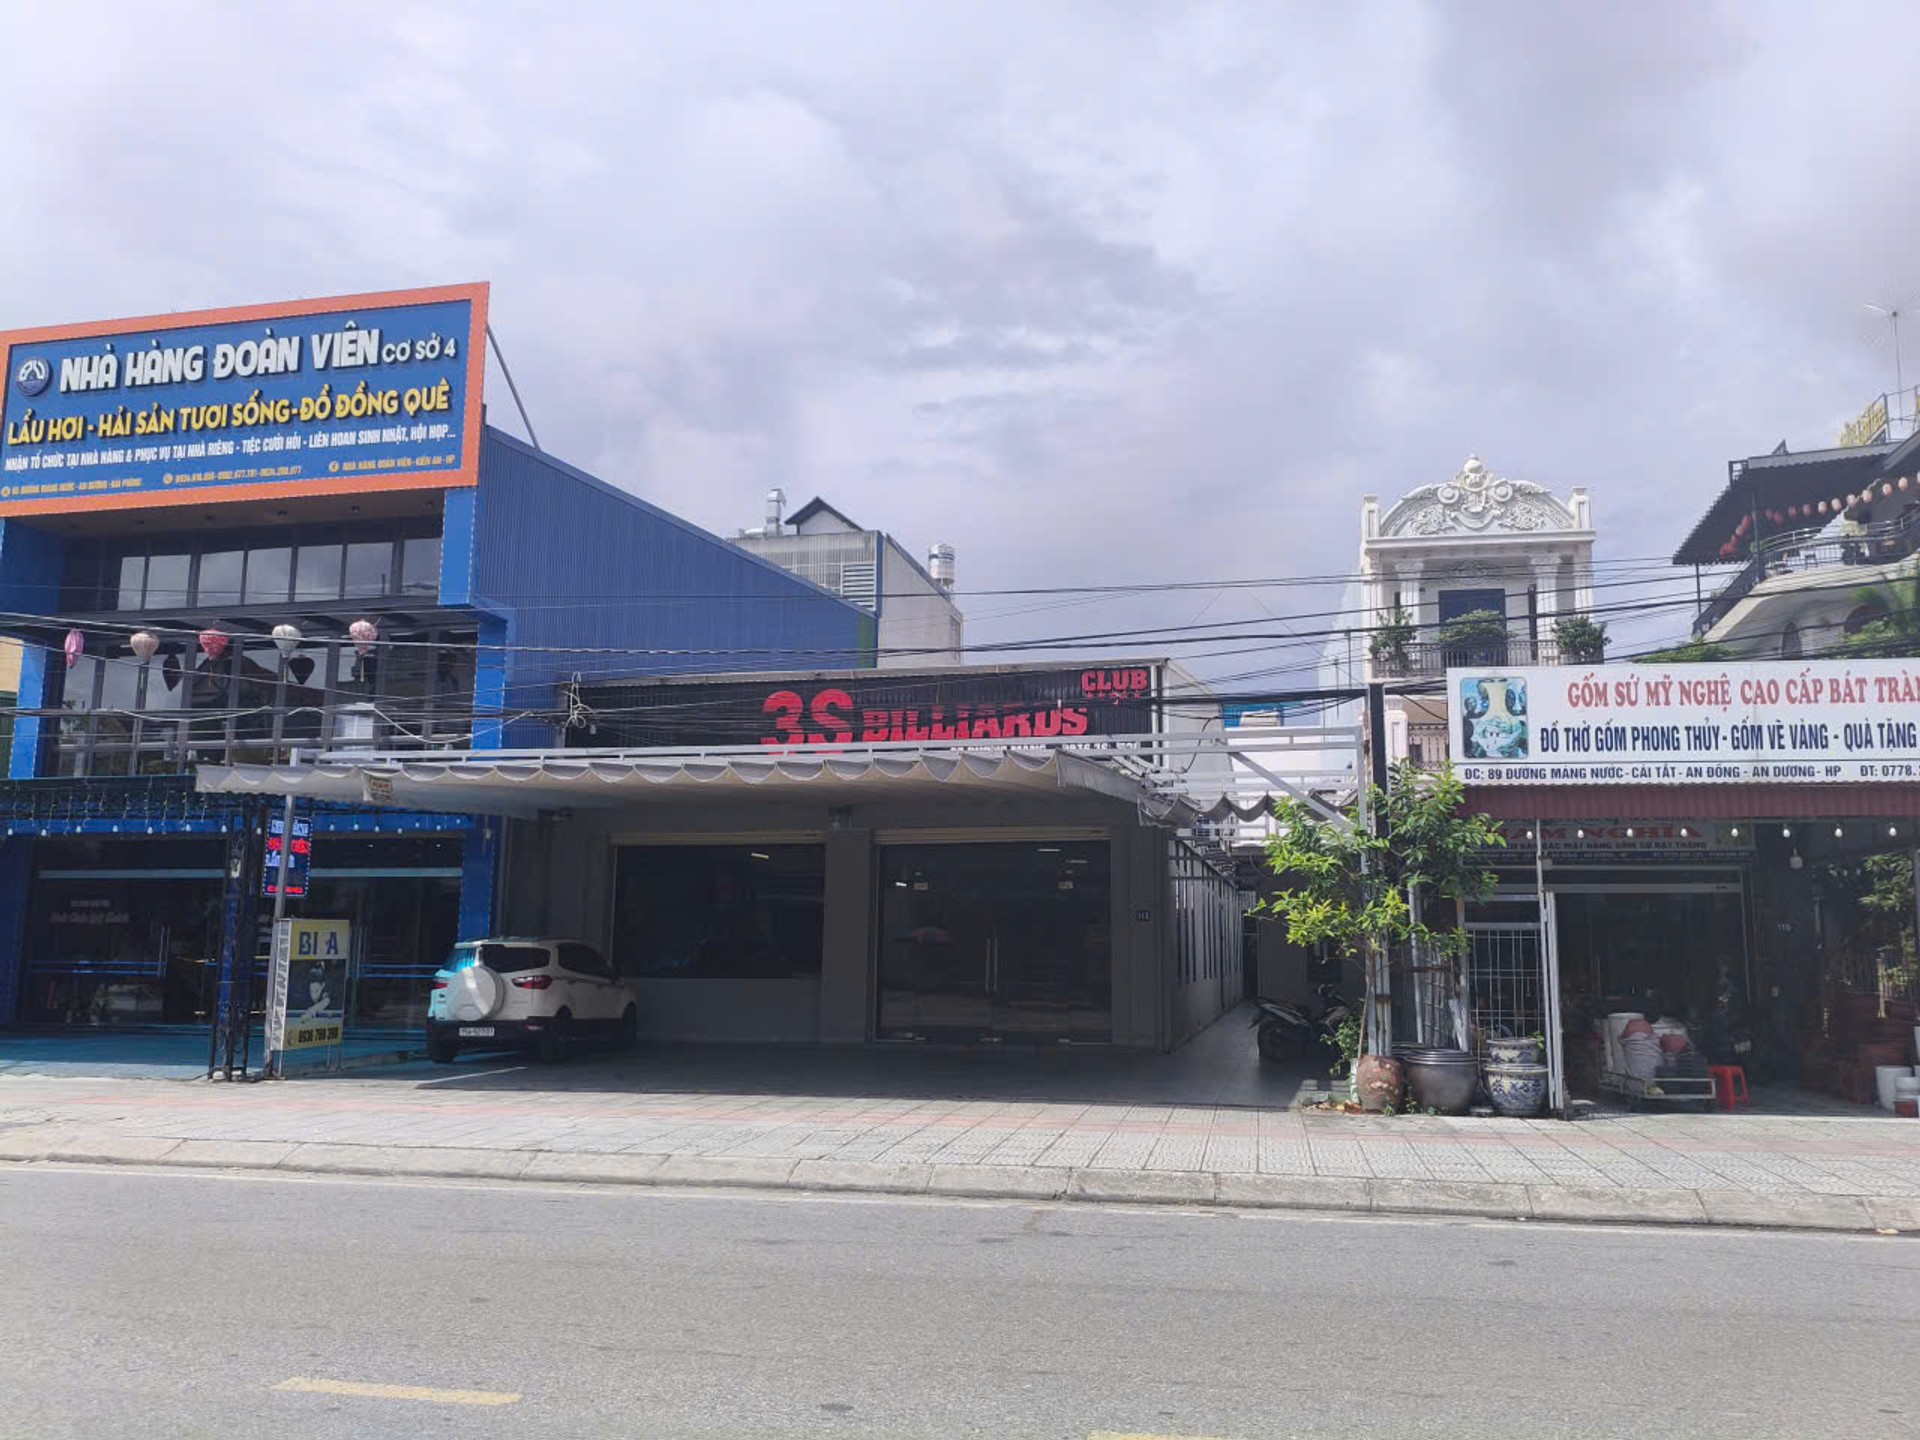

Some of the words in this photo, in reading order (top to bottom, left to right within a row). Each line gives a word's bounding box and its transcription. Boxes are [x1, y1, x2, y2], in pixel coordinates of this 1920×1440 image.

[60, 343, 119, 393] NHÀ
[125, 338, 205, 388] HÀNG
[213, 327, 300, 379] ĐOÀN
[311, 320, 380, 370] VIÊN
[382, 339, 412, 363] CƠ
[415, 332, 441, 360] SỞ
[444, 338, 457, 358] 4
[7, 407, 44, 446] LẨU
[48, 415, 84, 442] HƠI
[97, 405, 132, 438] HẢI
[135, 401, 175, 435] SẢN
[179, 402, 227, 431] TƯƠI
[335, 380, 399, 419] ĐỒNG
[404, 377, 451, 417] QUÊ
[125, 449, 133, 462] &
[135, 447, 158, 464] PHỤC
[159, 446, 171, 462] VỤ
[173, 444, 186, 461] TẠI
[207, 439, 234, 456] RIÊNG
[242, 436, 261, 456] TIỆC
[309, 430, 329, 448] LIÊN
[331, 432, 356, 447] HOAN
[358, 429, 381, 444] SINH
[411, 423, 427, 443] HỘI
[1082, 669, 1148, 691] CLUB
[1567, 672, 1609, 708] GỐM
[1614, 673, 1641, 707] SỨ
[1646, 675, 1674, 707] MỸ
[1679, 673, 1732, 713] NGHỆ
[1740, 679, 1780, 705] CAO
[1785, 667, 1824, 705] CẤP
[1829, 670, 1868, 704] BÁT
[760, 688, 855, 755] 3S
[862, 703, 1088, 741] BILLIARDS
[1564, 720, 1591, 752] THỜ
[1595, 718, 1627, 752] GỐM
[1632, 725, 1680, 752] PHONG
[1685, 716, 1720, 751] THỦY
[1731, 716, 1763, 750] GỐM
[1767, 719, 1785, 750] VẼ
[1789, 718, 1829, 750] VÀNG
[1844, 718, 1874, 752] QUÀ
[1877, 718, 1917, 752] TẶNG
[1465, 768, 1484, 780] ĐC:
[1488, 768, 1501, 780] 89
[1506, 764, 1547, 780] ĐƯỜNG
[1551, 764, 1587, 780] MÁNG
[1591, 764, 1623, 779] NƯỚC
[1632, 764, 1651, 778] CÁI
[1686, 766, 1702, 778] AN
[1752, 766, 1770, 778] AN
[1825, 766, 1842, 777] HP
[1860, 765, 1879, 777] ĐT:
